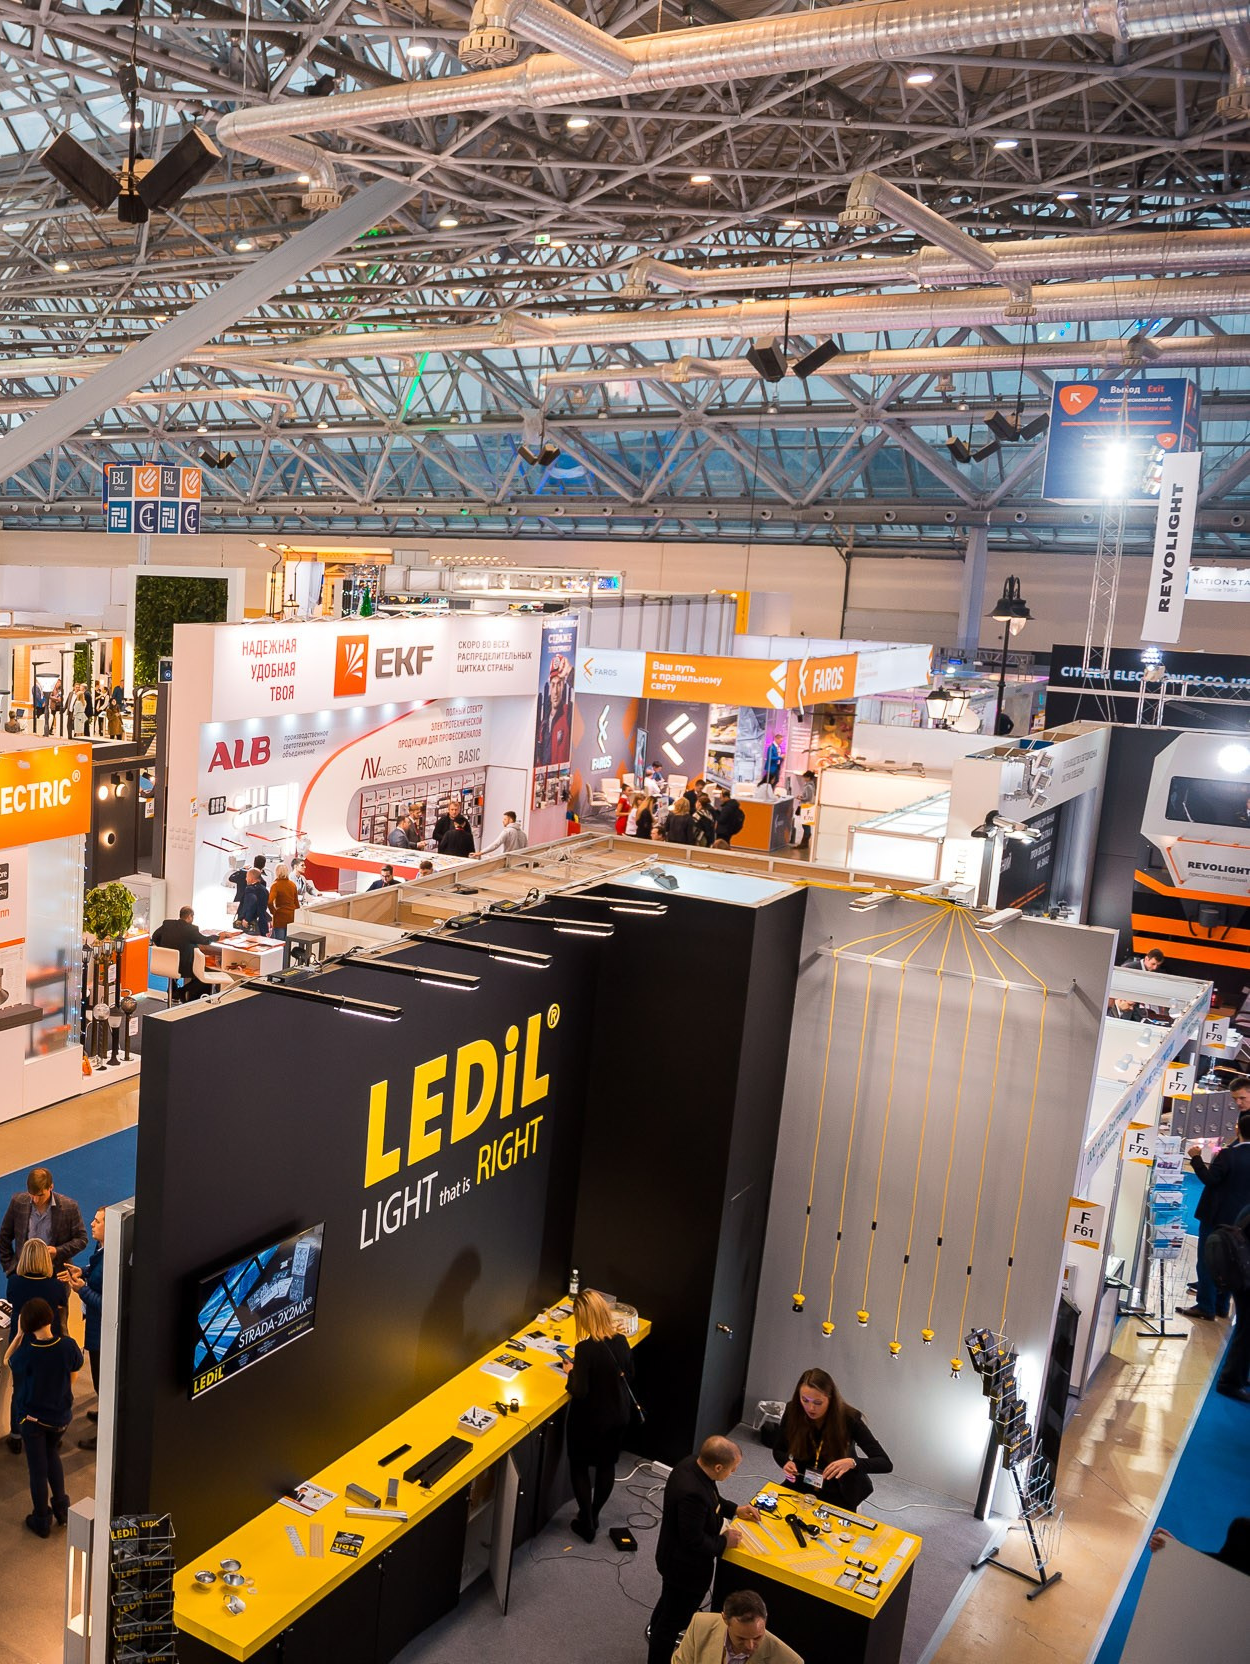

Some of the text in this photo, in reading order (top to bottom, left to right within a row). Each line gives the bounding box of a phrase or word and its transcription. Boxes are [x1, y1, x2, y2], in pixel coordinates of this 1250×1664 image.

[1110, 385, 1165, 395] Выход Exit
[112, 471, 128, 485] BL
[163, 470, 177, 485] BL
[1158, 483, 1184, 613] REVOLIGHT
[242, 638, 297, 657] НАДЕЖНАЯ
[458, 639, 481, 649] СКОРО
[482, 639, 493, 649] ВО
[375, 645, 434, 678] EKF
[457, 650, 533, 661] РАСПРЕДЕЛИТЕЛЬНЫХ
[251, 662, 296, 681] УДОБНАЯ
[456, 663, 515, 674] ЩИТКАХ СТРАНЫ
[594, 668, 618, 677] FAROS
[652, 661, 696, 674] Ваш путь
[1060, 666, 1110, 679] CITZEN
[659, 674, 722, 687] правильному
[812, 665, 844, 693] FAROS
[270, 685, 295, 702] ТВОЯ
[651, 683, 676, 693] свету
[207, 735, 271, 773] ALB
[458, 747, 481, 764] BASIC
[417, 754, 451, 770] PROxima
[1187, 861, 1250, 875] REVOLIGHT
[1211, 1022, 1220, 1033] F
[1205, 1032, 1223, 1042] F79
[1175, 1071, 1184, 1082] F
[1168, 1081, 1188, 1092] F77
[1136, 1132, 1145, 1144] F
[1128, 1144, 1149, 1156] F75
[360, 1115, 544, 1250] LIGHT that is RIGHT
[1080, 1211, 1091, 1225] F
[1073, 1224, 1094, 1238] F61
[193, 1365, 225, 1394] LEDiL
[111, 1527, 138, 1540] LEDiL
